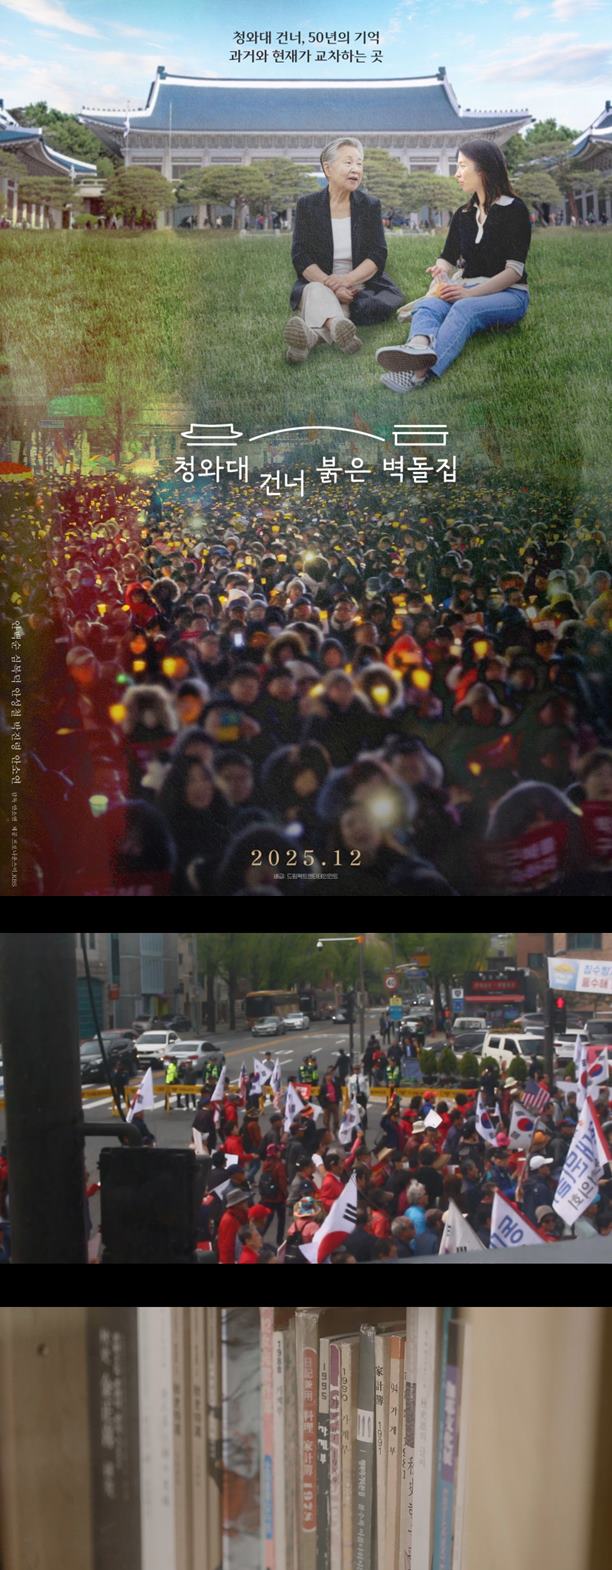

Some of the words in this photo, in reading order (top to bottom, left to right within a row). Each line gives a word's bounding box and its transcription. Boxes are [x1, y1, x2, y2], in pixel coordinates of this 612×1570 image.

[232, 30, 272, 45] 청와대
[275, 30, 305, 45] 건너,
[308, 30, 350, 45] 50년의
[354, 30, 380, 45] 기억
[229, 49, 269, 63] 과거와
[272, 49, 312, 63] 현재가
[314, 49, 367, 63] 교차하는
[370, 49, 384, 63] 곳
[174, 456, 249, 483] 청와대
[259, 469, 305, 498] 건너
[315, 456, 372, 484] 붉은
[382, 456, 458, 484] 벽돌집
[250, 848, 362, 867] 2025.12
